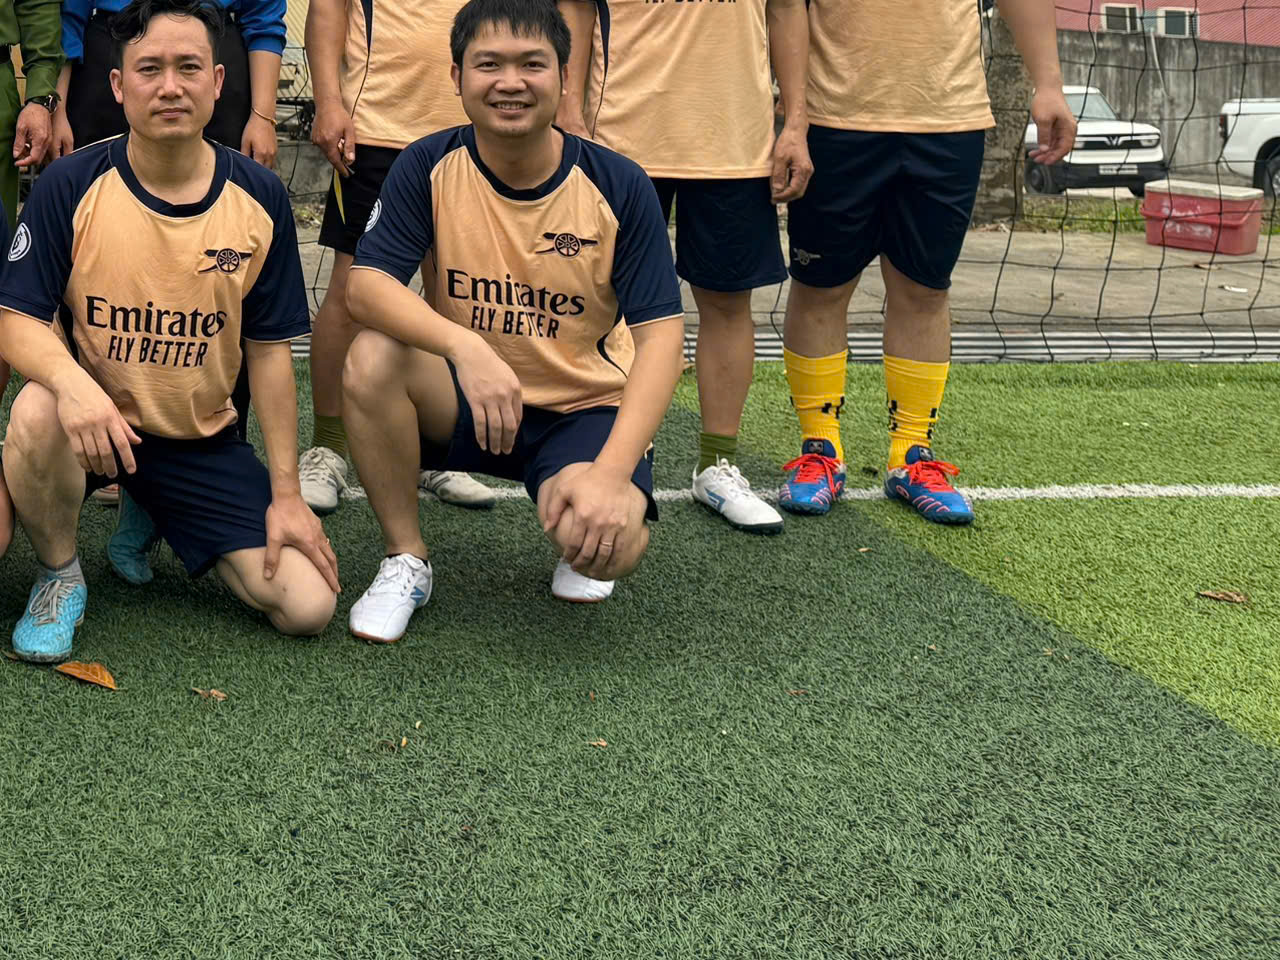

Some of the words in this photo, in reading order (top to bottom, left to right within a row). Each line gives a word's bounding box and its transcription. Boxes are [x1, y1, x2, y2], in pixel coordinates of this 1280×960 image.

[86, 295, 228, 338] Emirates
[471, 305, 497, 332] FLY
[107, 335, 136, 363] FLY
[139, 339, 210, 368] BETTER
